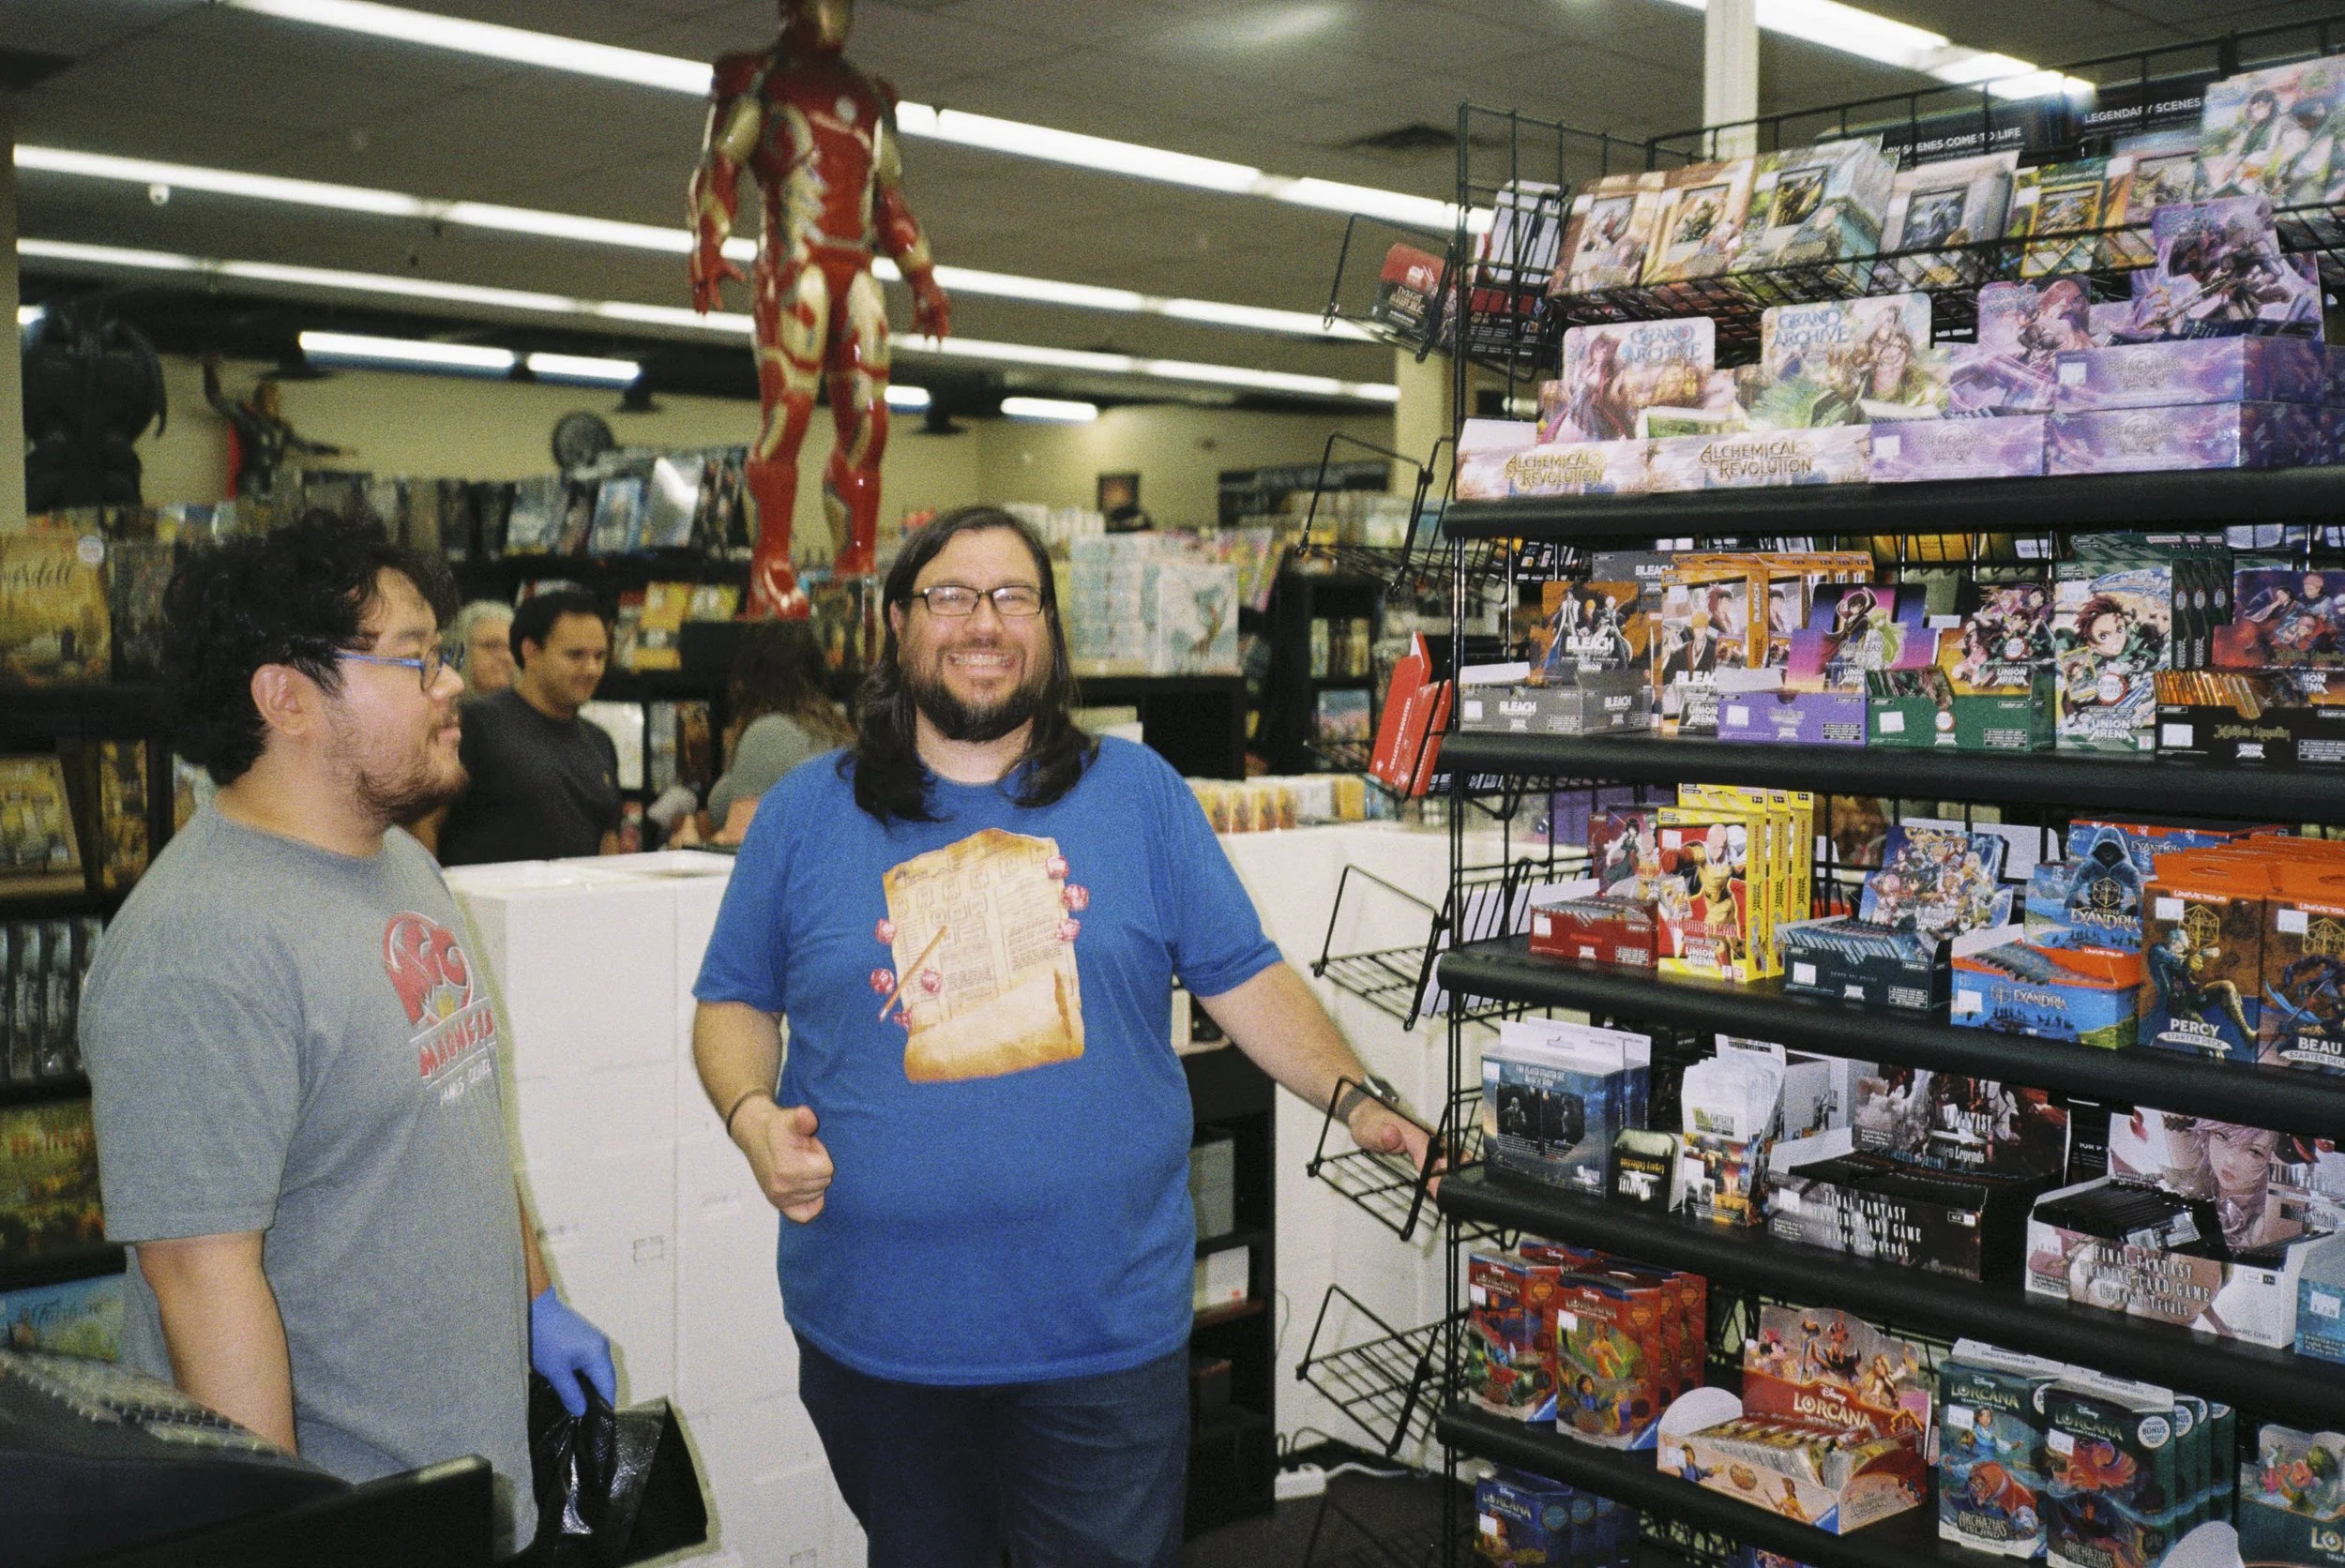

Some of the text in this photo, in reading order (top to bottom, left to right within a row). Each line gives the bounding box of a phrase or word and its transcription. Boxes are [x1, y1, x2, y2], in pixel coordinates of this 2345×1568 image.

[2156, 97, 2201, 113] SCENES
[1945, 134, 1977, 151] COME
[1997, 127, 2022, 141] LIFE
[1778, 308, 1842, 330] GRAND
[1630, 324, 1696, 345] GRAND
[1773, 325, 1851, 348] ARCHIVE
[1626, 342, 1702, 364] ARCHIVE
[1700, 441, 1802, 463] ALCHEMICAL
[1505, 452, 1592, 474] ALCHEMICAL
[1718, 456, 1814, 479] REVOLUTION
[1520, 467, 1606, 488] REVOLUTION
[1566, 636, 1614, 651] BLEACH
[1676, 671, 1717, 686] BLEA
[1839, 675, 1865, 684] AREN
[1844, 668, 1866, 676] UNIO
[1992, 676, 2031, 687] ARENA
[1997, 668, 2028, 677] UNION
[1500, 701, 1536, 714] BLEACH
[1605, 696, 1632, 708] BLEACH
[1687, 704, 1718, 716] UNION
[1687, 715, 1718, 727] ARENA
[2090, 718, 2131, 729] UNION
[2087, 728, 2137, 742] ARENA
[1717, 923, 1738, 937] MAN
[1917, 918, 1944, 927] UNION
[2070, 908, 2142, 934] EXANDRIA
[1686, 946, 1716, 957] UNION
[2013, 988, 2069, 1011] EXANDRIA
[2170, 1018, 2220, 1038] PERCY
[2165, 1033, 2223, 1048] STARTER DECK
[2298, 1036, 2342, 1055] BEAU
[2289, 1051, 2325, 1062] STARTER
[1955, 1145, 1985, 1164] Legends
[1824, 1191, 1907, 1222] FINAL FANTASY
[1893, 1223, 1922, 1243] GAME
[1866, 1234, 1909, 1258] Legends
[2094, 1245, 2192, 1280] FINAL FANTASY
[2080, 1260, 2210, 1303] TRADING CARD GAME
[2099, 1282, 2188, 1317] Hidden Trials
[2000, 1354, 2020, 1364] PLAYER
[1972, 1374, 1996, 1389] Disney
[1819, 1382, 1847, 1404] Disney
[1951, 1385, 2020, 1410] LORCANA
[1793, 1391, 1871, 1429] LORCANA
[2074, 1402, 2099, 1420] Disney
[2054, 1409, 2124, 1442] LORCANA
[2142, 1425, 2167, 1435] BONUS
[1481, 1492, 1532, 1519] LORCANA
[1965, 1525, 2001, 1539] ISLAND
